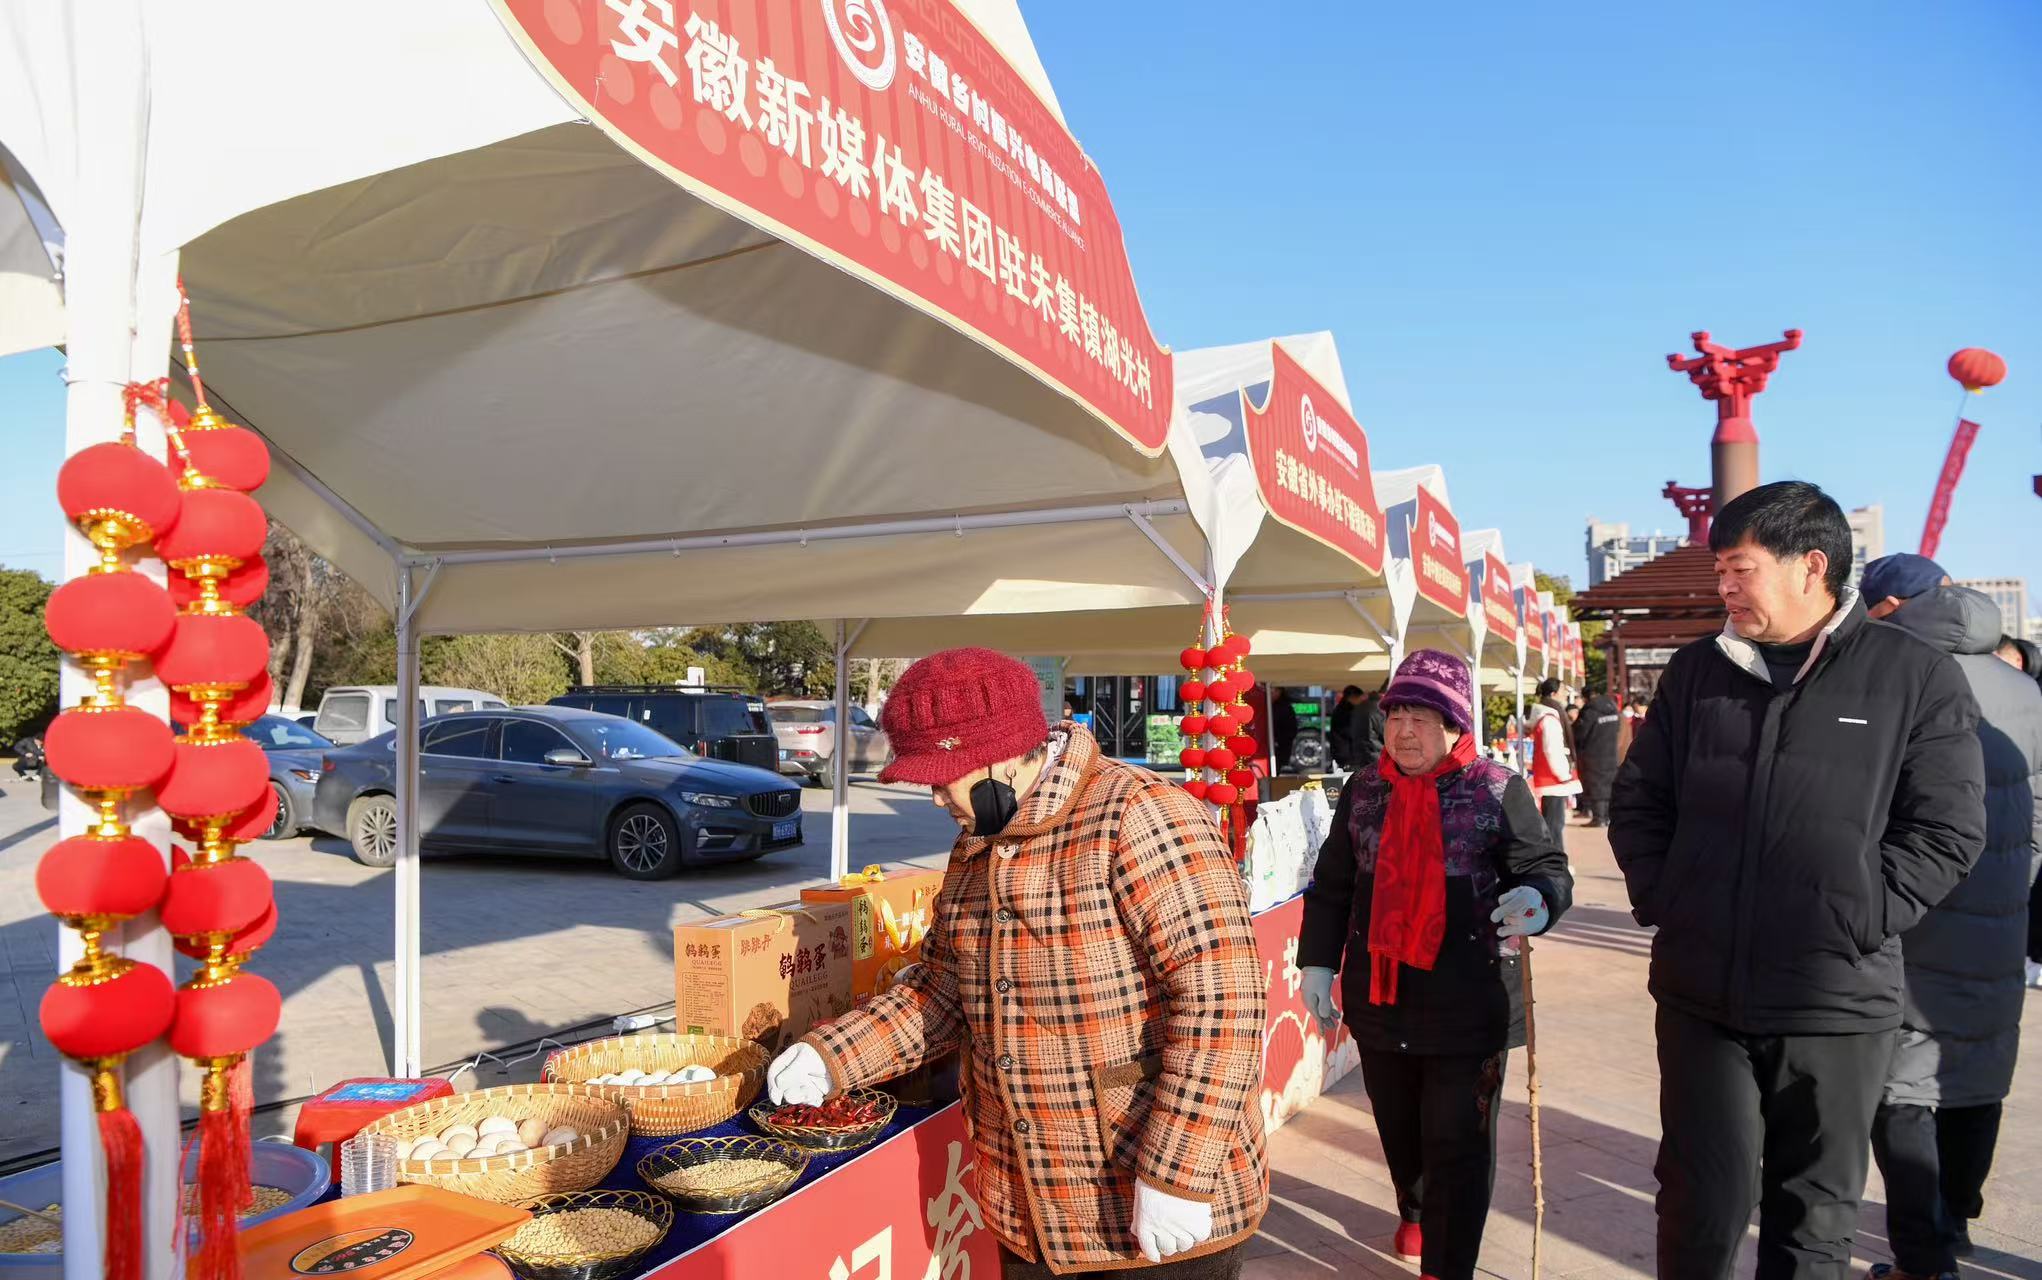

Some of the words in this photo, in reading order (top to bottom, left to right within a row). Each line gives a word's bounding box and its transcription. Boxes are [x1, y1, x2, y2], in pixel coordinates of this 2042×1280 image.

[908, 83, 939, 121] ANHUI
[939, 107, 967, 141] RURAL
[609, 0, 1153, 410] 安徽新媒体集团驻朱集镇湖光村
[685, 943, 721, 960] 鹌鹑蛋
[779, 943, 827, 980] 鹌鹑蛋
